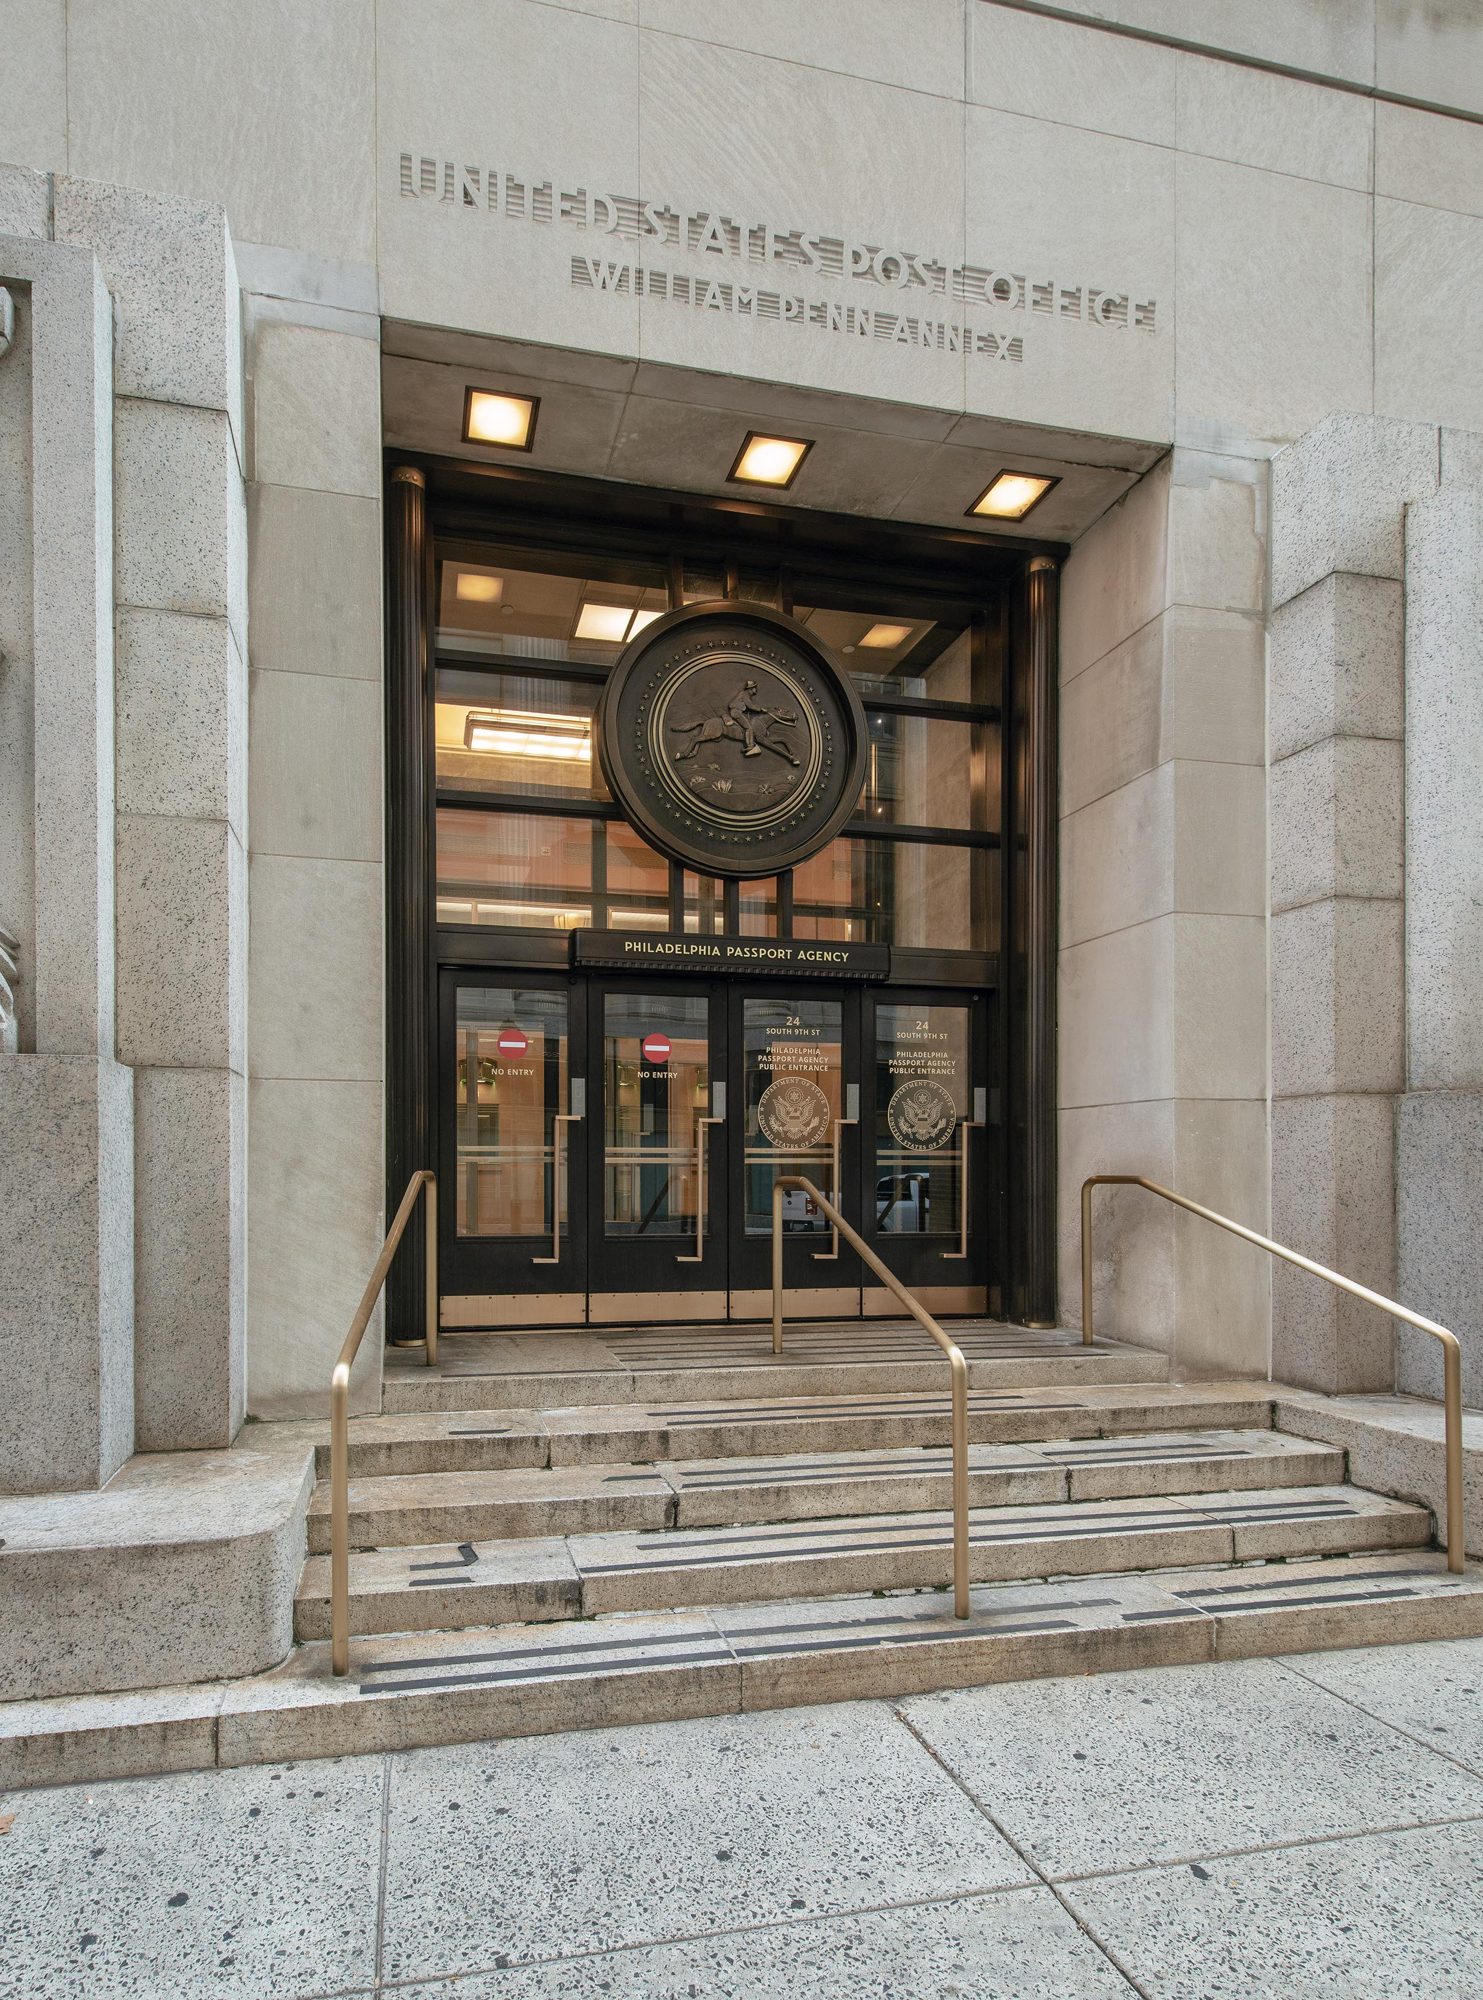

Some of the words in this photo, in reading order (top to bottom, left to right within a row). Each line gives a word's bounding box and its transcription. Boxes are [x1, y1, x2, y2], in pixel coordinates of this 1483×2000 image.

[405, 153, 618, 235] UNITED
[643, 200, 822, 274] STATES
[843, 243, 963, 299] POST
[984, 270, 1156, 335] OFFICE
[583, 256, 759, 316] WILLIAM
[779, 296, 876, 338] PENN
[891, 315, 1018, 363] ANNEX
[624, 941, 721, 956] PHILADELPHIA
[727, 946, 793, 960] PASSPORT
[797, 950, 849, 962] AGENCY
[786, 1016, 800, 1026] 24
[915, 1020, 929, 1030] 24
[766, 1027, 792, 1035] SOUTH
[896, 1031, 921, 1039] SOUTH
[766, 1046, 821, 1055] PHILADELPHIA
[757, 1054, 796, 1063] PASSPORT
[798, 1056, 829, 1064] AGENCY
[491, 1068, 505, 1076] NO
[507, 1068, 534, 1076] ENTRY
[759, 1063, 787, 1071] PUBLIC
[788, 1064, 829, 1072] ENTRANCE
[652, 1071, 678, 1079] ENTRY
[761, 1079, 799, 1104] DEPARTMENT
[811, 1086, 826, 1105] STATE
[891, 1081, 928, 1106] DEPARTMENT
[939, 1089, 953, 1105] STATE
[760, 1114, 774, 1140] UNITED
[775, 1139, 799, 1148] STATES
[811, 1115, 828, 1143] AMERICA
[889, 1116, 904, 1141] UNITED
[904, 1140, 927, 1150] STATES
[938, 1117, 955, 1144] AMERICA
